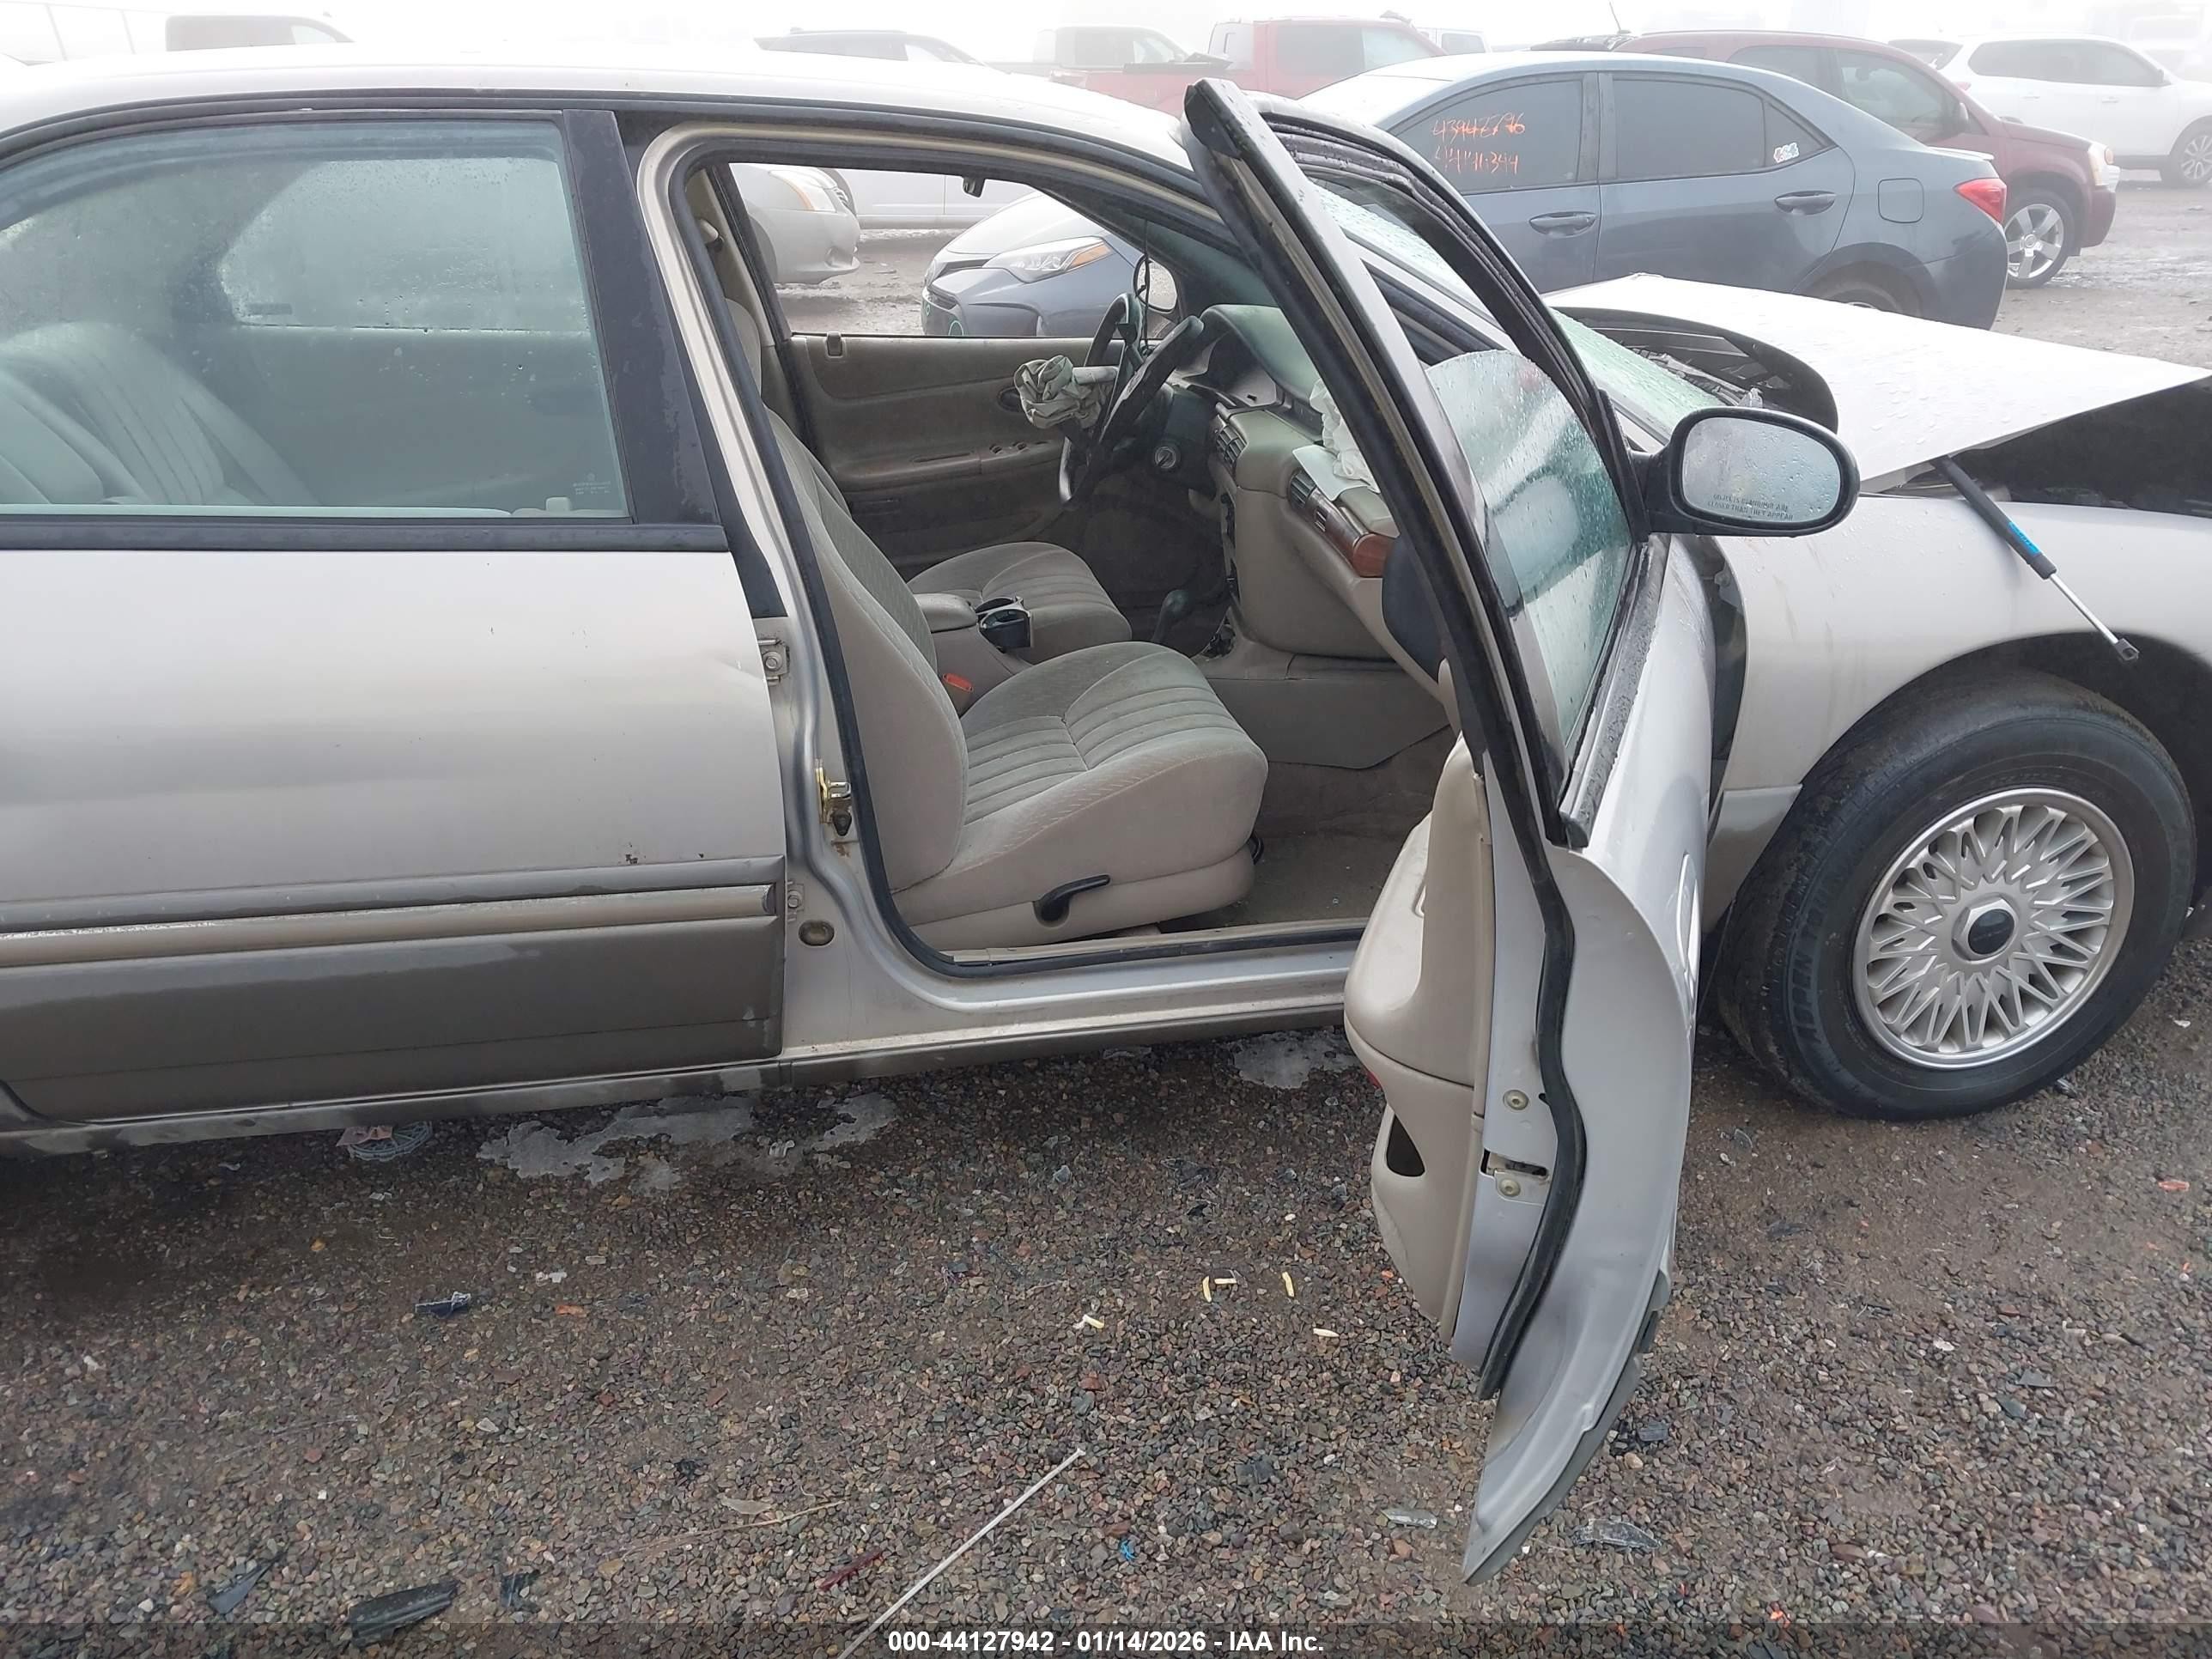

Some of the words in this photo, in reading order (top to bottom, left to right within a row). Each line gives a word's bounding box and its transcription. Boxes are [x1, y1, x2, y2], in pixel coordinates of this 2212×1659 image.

[1731, 504, 1748, 514] THAN
[1750, 507, 1766, 516] THEY
[1767, 511, 1793, 521] APPEAR
